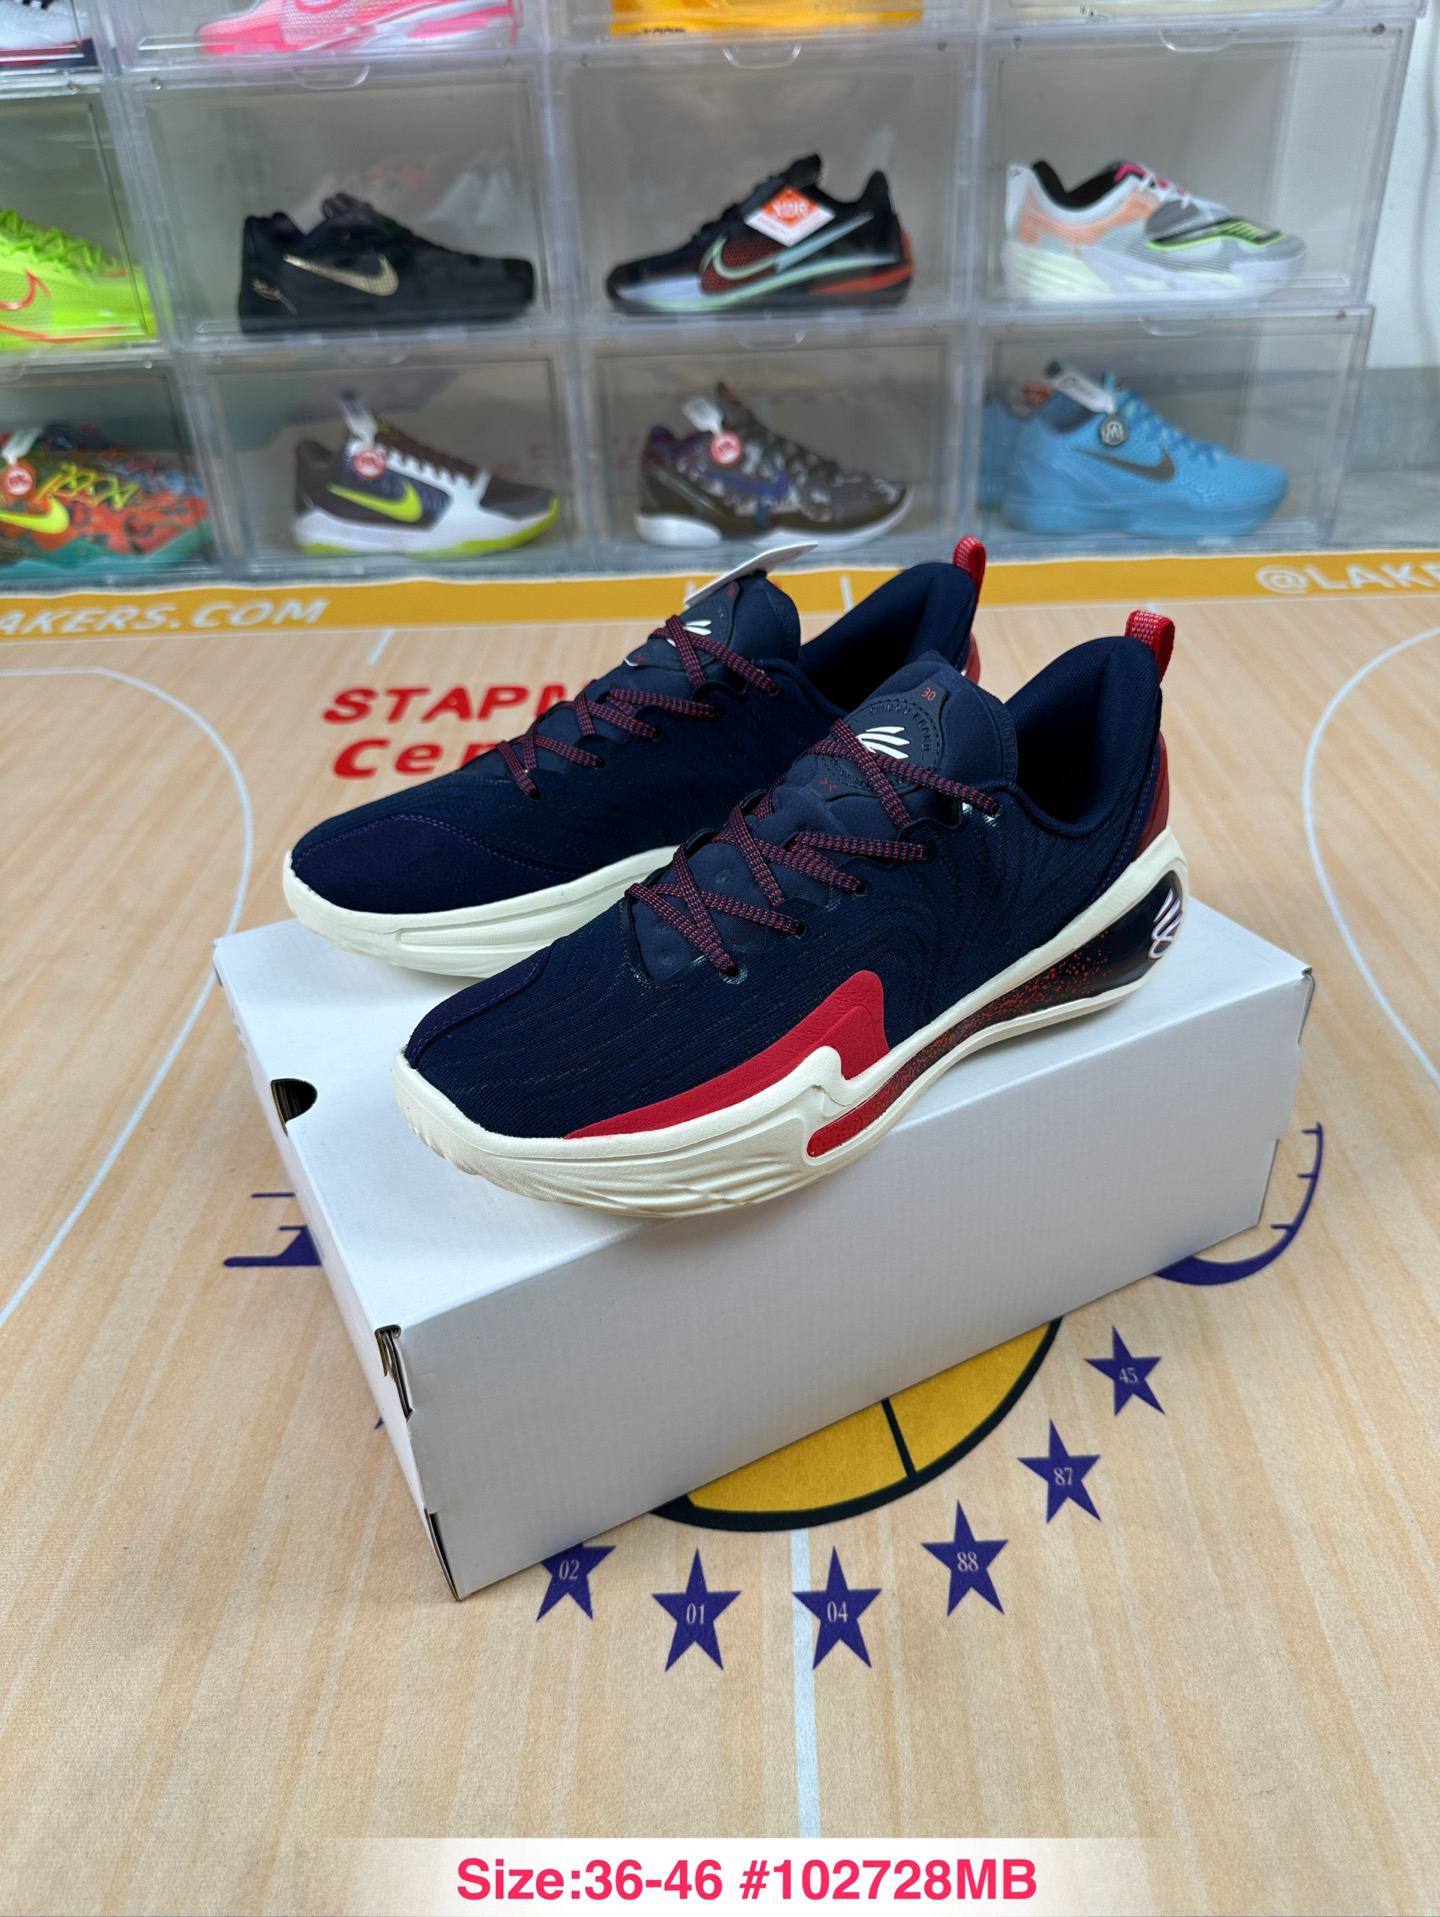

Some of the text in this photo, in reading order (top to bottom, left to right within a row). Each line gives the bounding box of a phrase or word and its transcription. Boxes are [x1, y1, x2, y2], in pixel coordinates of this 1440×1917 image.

[1119, 1368, 1138, 1384] 45
[1053, 1467, 1073, 1486] 87
[558, 1559, 581, 1581] 02
[956, 1551, 979, 1571] 88
[686, 1603, 706, 1625] 01
[827, 1601, 849, 1623] 04
